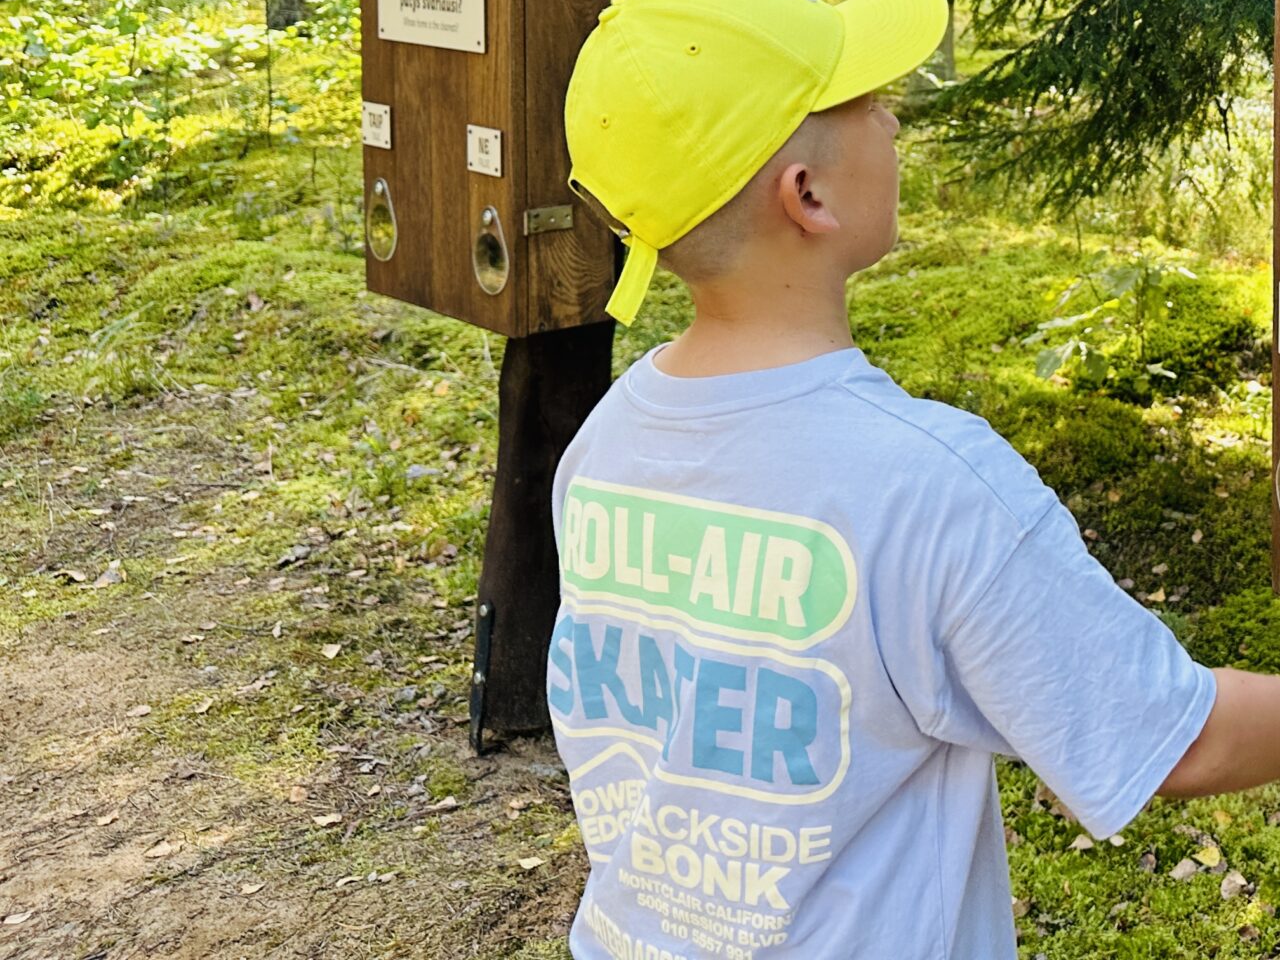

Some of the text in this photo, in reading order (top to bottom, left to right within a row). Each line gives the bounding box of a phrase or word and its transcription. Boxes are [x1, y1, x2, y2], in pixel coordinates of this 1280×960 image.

[563, 495, 814, 628] ROLL-AIR
[630, 794, 833, 865] ACKSIDE
[618, 868, 702, 913] MONTCLAIR
[630, 831, 792, 910] BONK
[672, 906, 735, 942] MISSION
